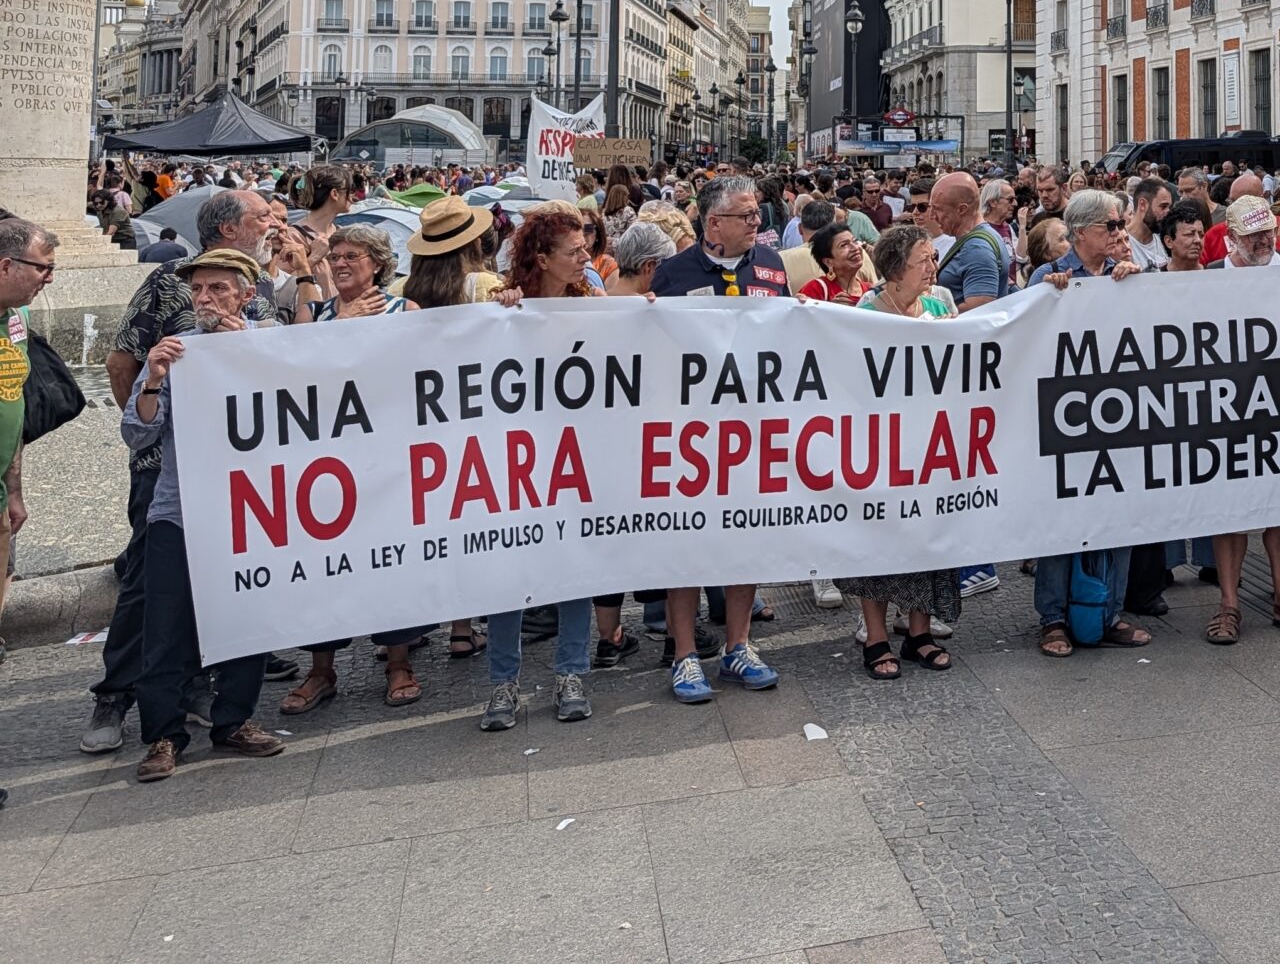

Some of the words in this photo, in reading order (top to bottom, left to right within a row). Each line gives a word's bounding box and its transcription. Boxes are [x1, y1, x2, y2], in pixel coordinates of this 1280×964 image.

[22, 0, 40, 11] DE
[36, 14, 60, 27] LAS
[7, 26, 88, 45] POBLACIONES
[20, 41, 78, 57] INTERNAS
[72, 60, 82, 71] DE
[73, 87, 84, 99] LA
[14, 98, 56, 110] OBRAS
[578, 139, 607, 151] CADA
[613, 140, 642, 151] CASA
[575, 154, 591, 163] UNA
[599, 154, 649, 164] TRINCHERA
[756, 269, 773, 279] UGT
[748, 288, 768, 296] UGT
[1054, 317, 1278, 377] MADRID
[226, 380, 374, 452] UNA
[415, 340, 641, 427] REGIÓN
[680, 349, 828, 405] PARA
[863, 341, 1002, 397] VIVIR
[1054, 375, 1279, 437] CONTRA
[229, 457, 357, 555] NO
[409, 426, 593, 526] PARA
[640, 405, 999, 498] ESPECULAR
[1056, 449, 1125, 499] LA
[235, 566, 271, 592] NO
[290, 561, 307, 583] A
[325, 553, 353, 577] LA
[371, 544, 406, 570] LEY
[424, 537, 448, 561] DE
[463, 524, 544, 555] IMPULSO
[556, 520, 566, 540] Y
[581, 511, 706, 537] DESARROLLO
[722, 503, 848, 529] EQUILIBRADO
[863, 501, 885, 521] DE
[900, 500, 921, 519] LA
[936, 485, 999, 515] REGIÓN
